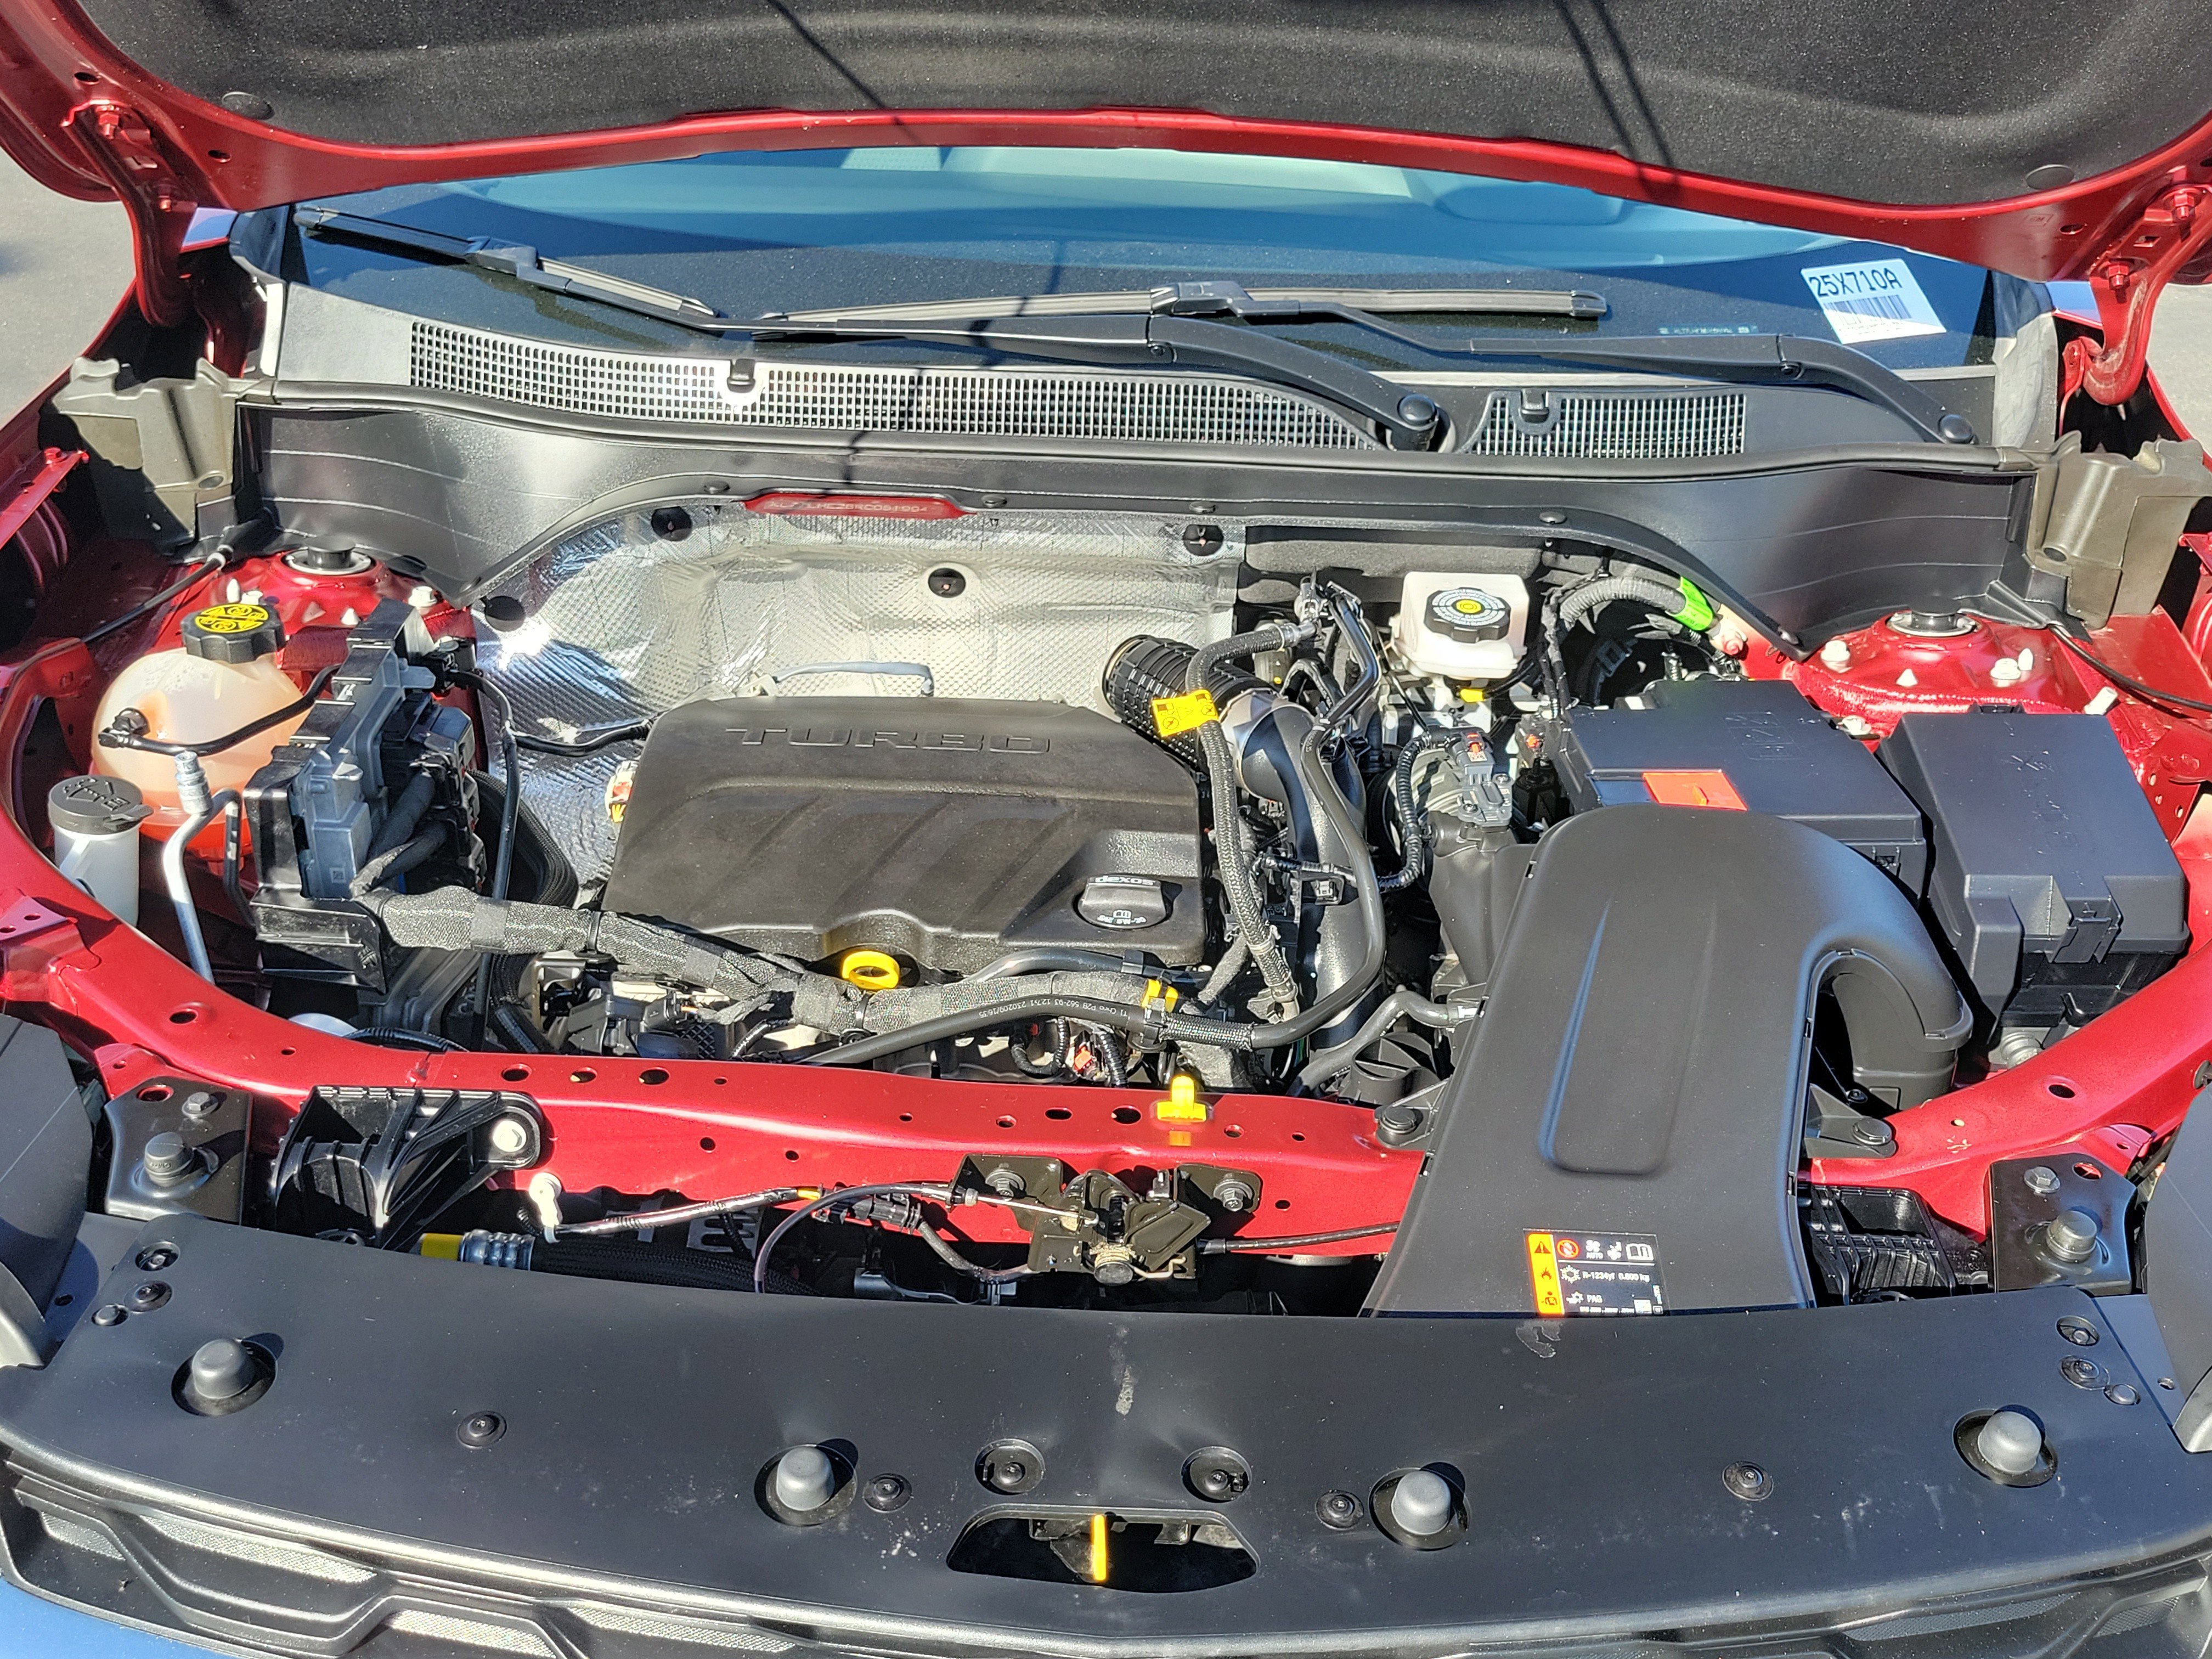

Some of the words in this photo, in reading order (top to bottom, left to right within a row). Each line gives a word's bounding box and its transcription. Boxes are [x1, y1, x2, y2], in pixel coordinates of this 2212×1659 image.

[1808, 268, 1903, 298] 25X710A
[725, 726, 1051, 754] TURBO
[1095, 875, 1156, 886] dexos
[1639, 1273, 1650, 1283] kg
[1586, 1294, 1603, 1304] PAG
